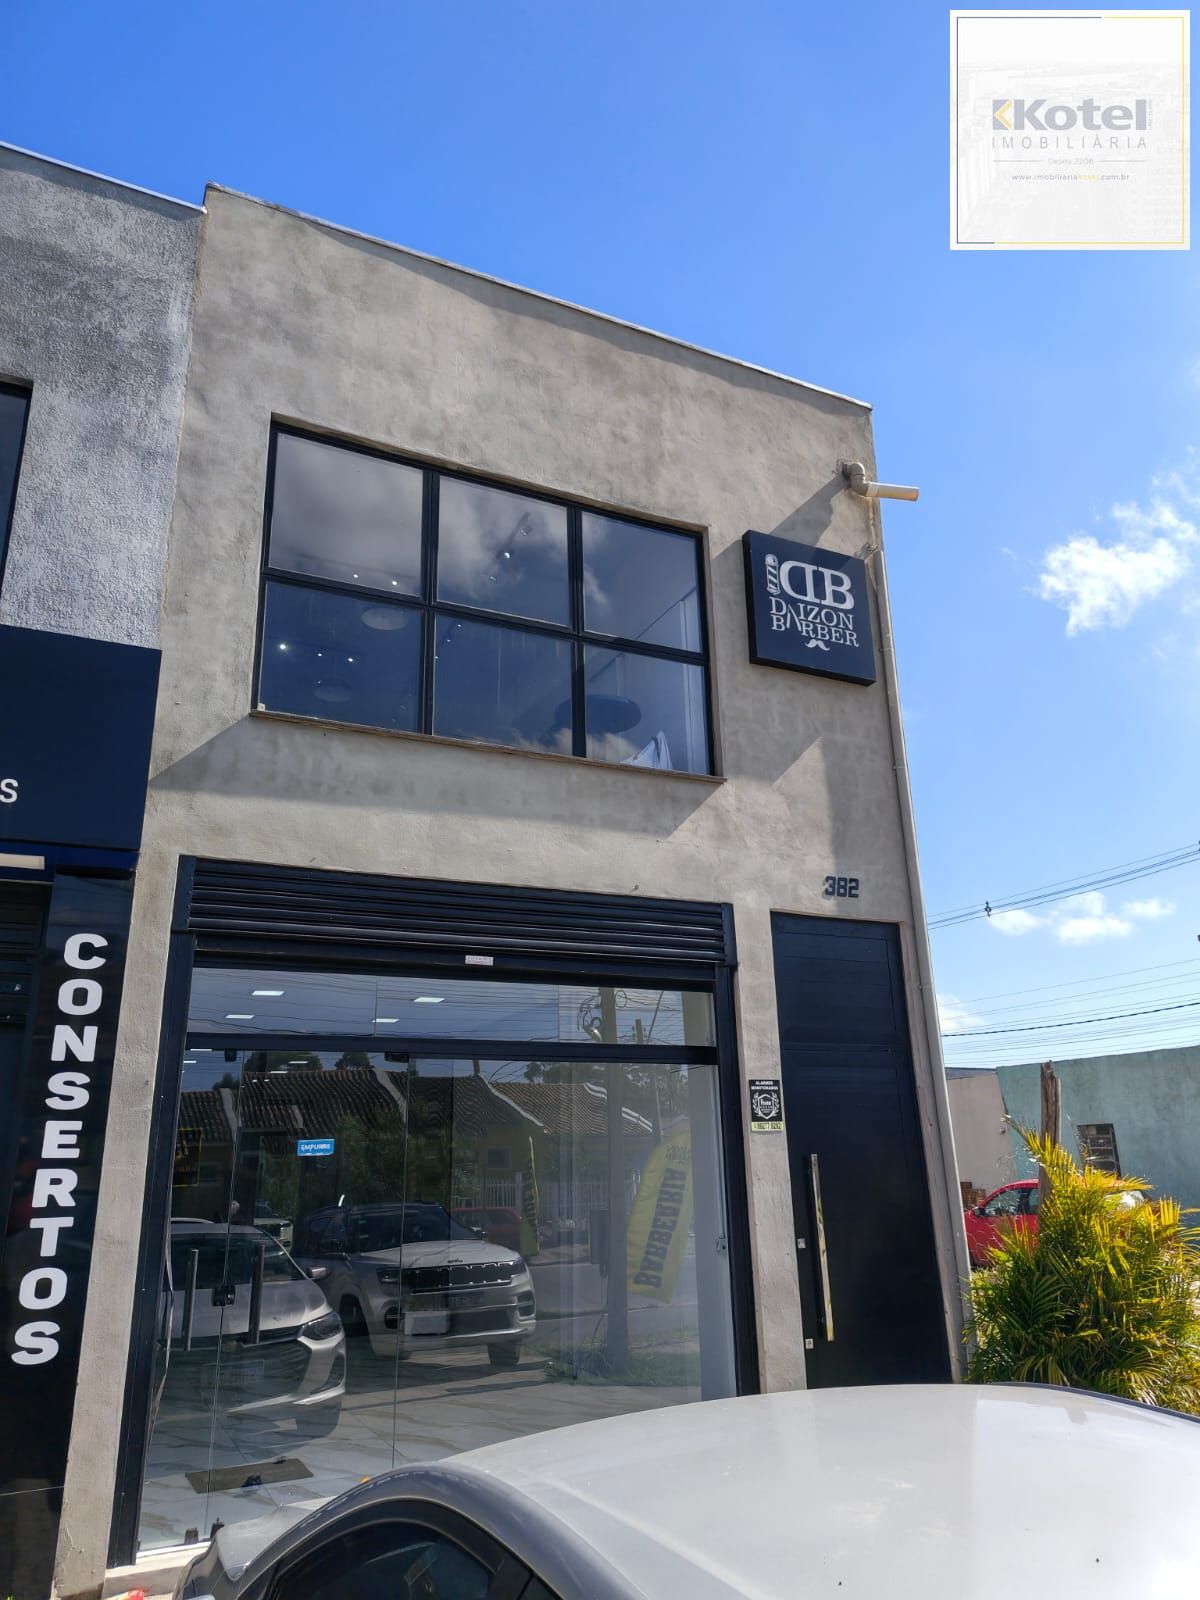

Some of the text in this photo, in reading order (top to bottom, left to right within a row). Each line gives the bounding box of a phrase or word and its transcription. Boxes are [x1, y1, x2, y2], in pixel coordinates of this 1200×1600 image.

[769, 596, 854, 631] DAIZON
[770, 604, 859, 648] BARBER
[824, 875, 860, 899] 382
[11, 933, 108, 1366] CONSERTOS
